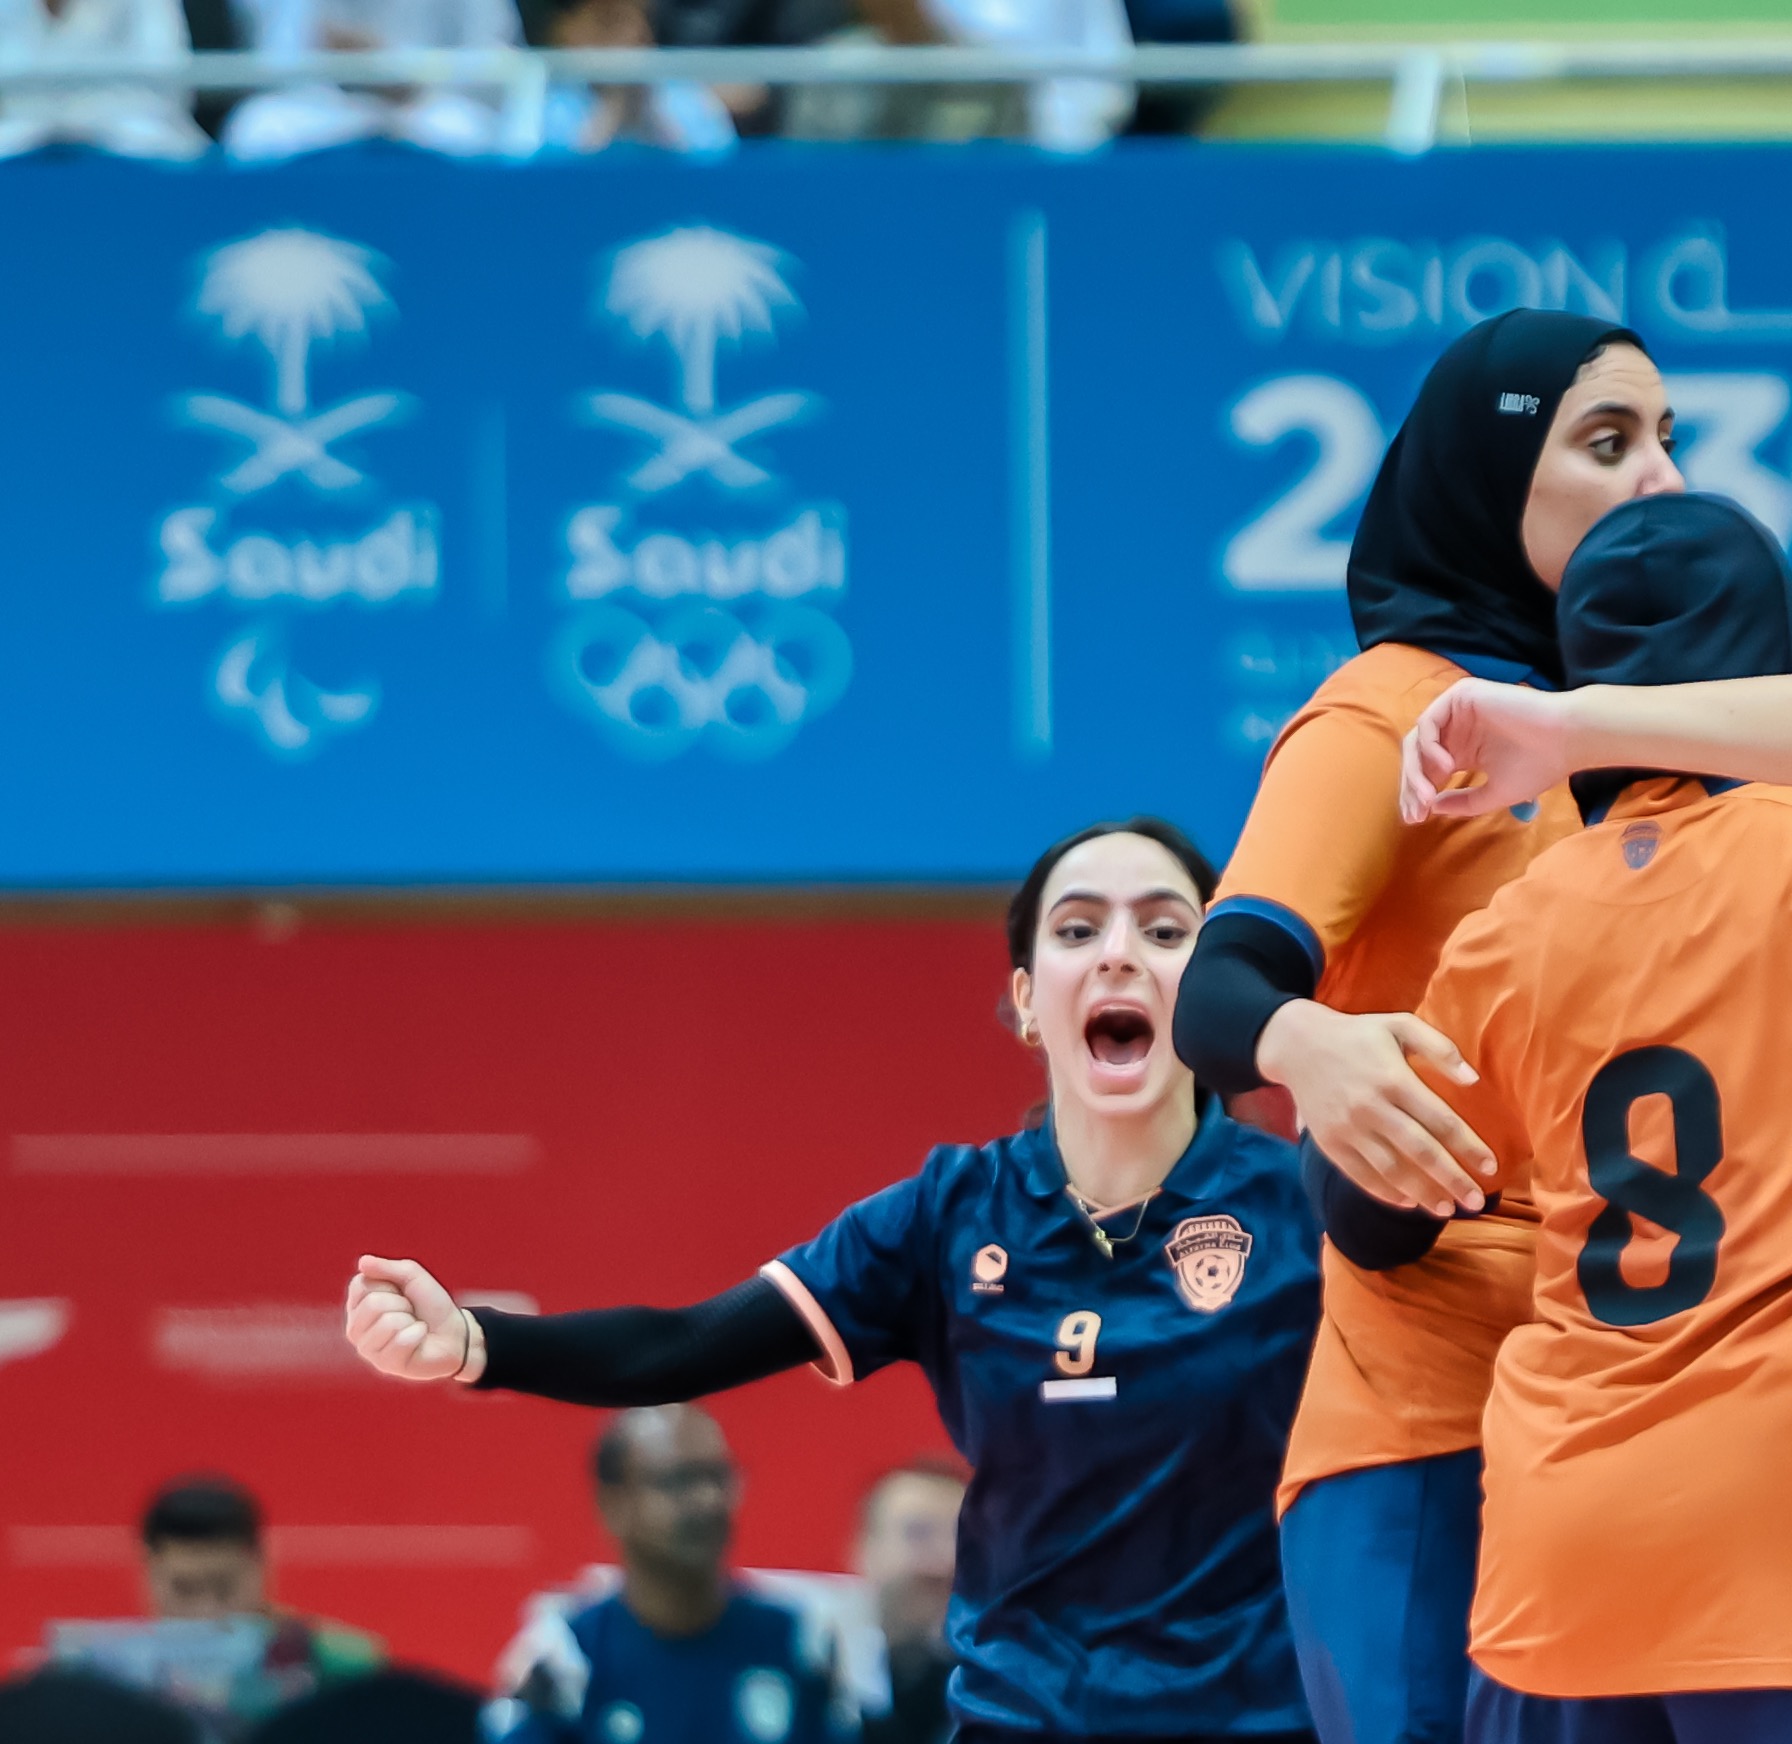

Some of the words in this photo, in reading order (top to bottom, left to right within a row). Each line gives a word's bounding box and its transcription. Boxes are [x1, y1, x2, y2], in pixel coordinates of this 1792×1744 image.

[1236, 240, 1627, 330] VISION
[157, 505, 440, 602] Saudi
[564, 505, 846, 600] Saudi
[1576, 1044, 1725, 1327] 8
[1055, 1310, 1102, 1375] 9
